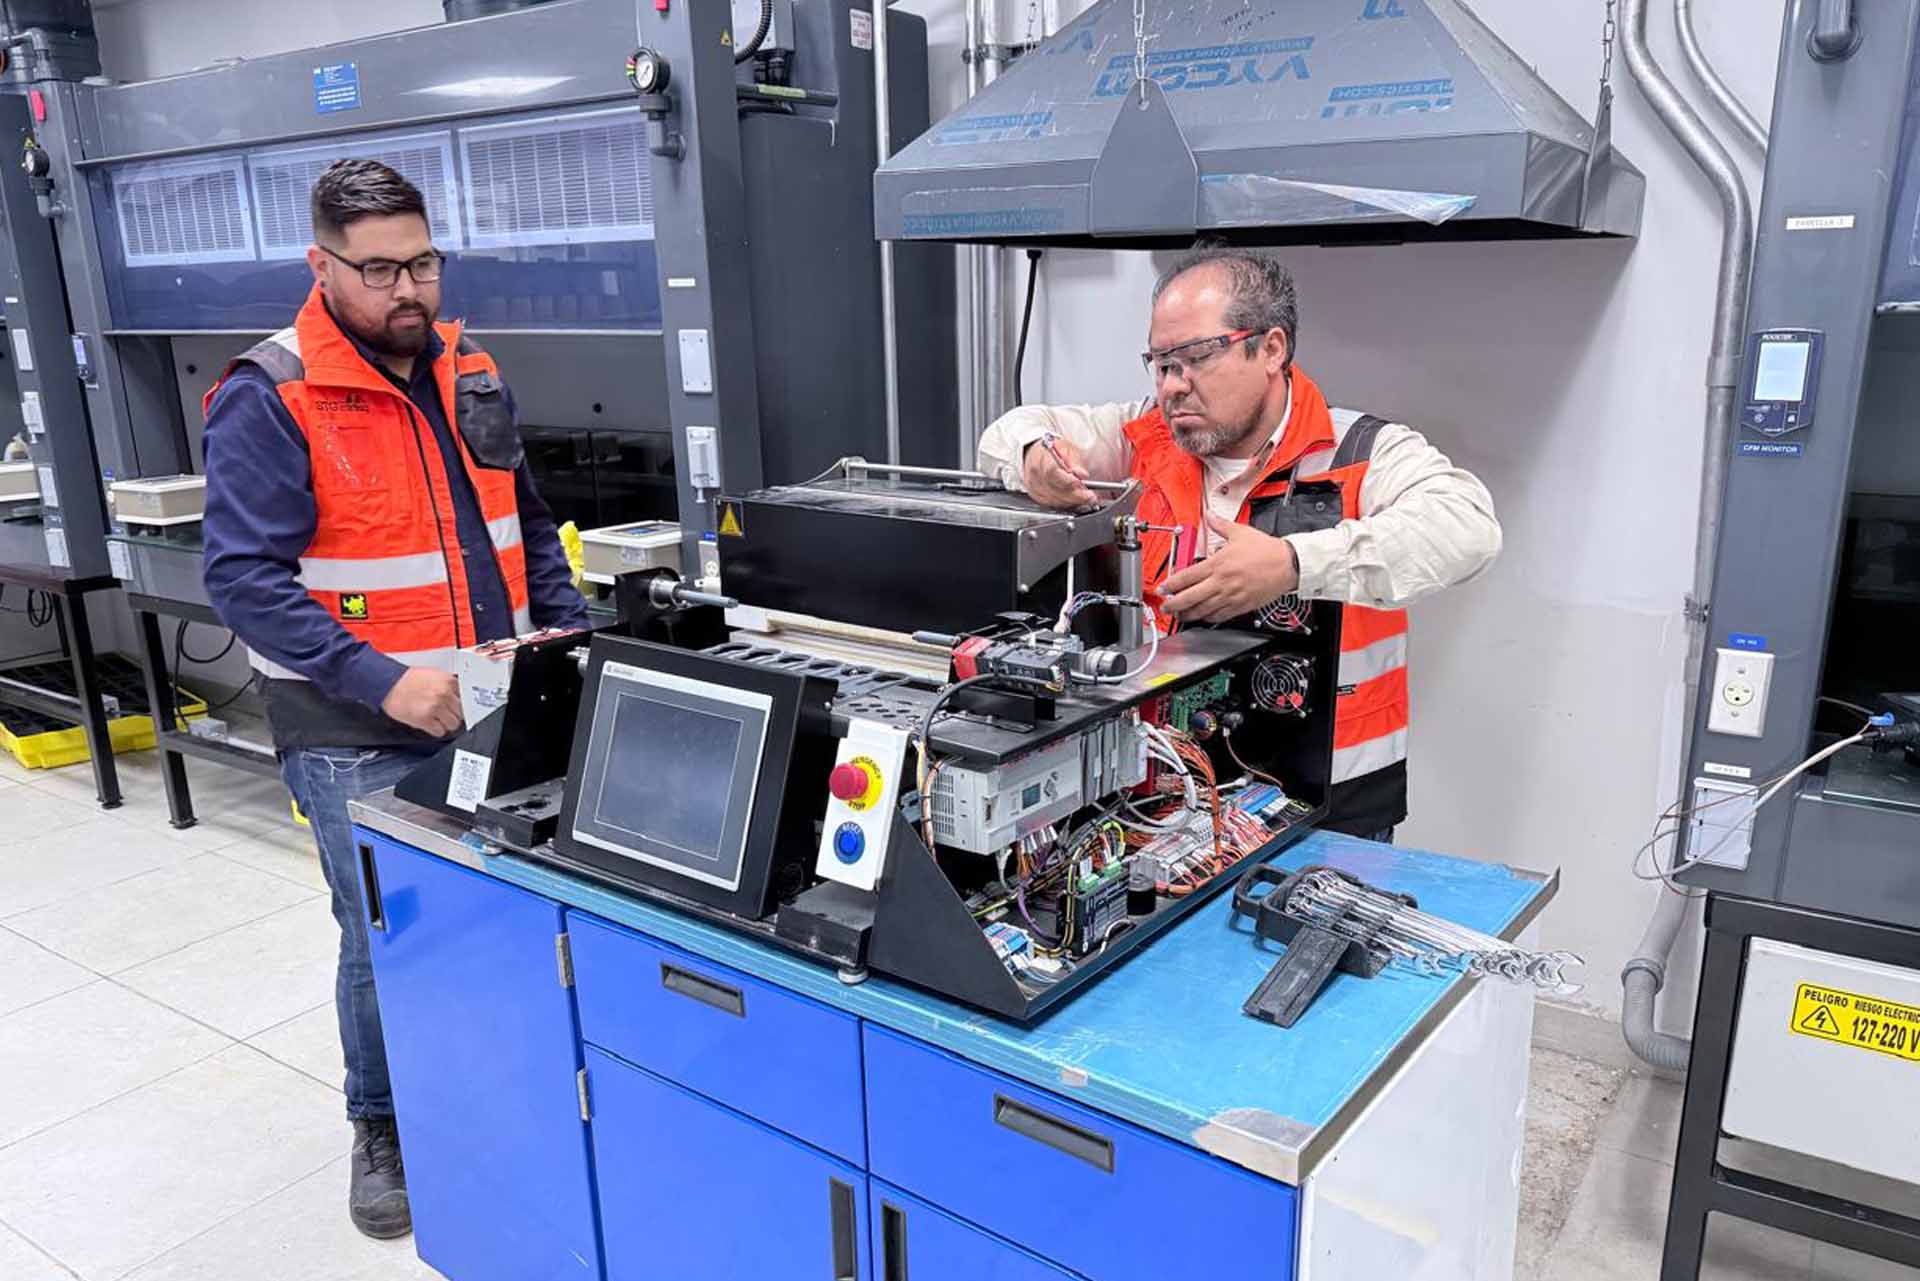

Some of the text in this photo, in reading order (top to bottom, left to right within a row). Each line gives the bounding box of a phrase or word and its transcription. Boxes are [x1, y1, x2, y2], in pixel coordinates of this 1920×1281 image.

[1743, 444, 1798, 453] CFM MONITOR
[1804, 990, 1848, 1007] PELIGRO
[1855, 1000, 1882, 1015] RIESGO
[1852, 1017, 1906, 1049] 127-220
